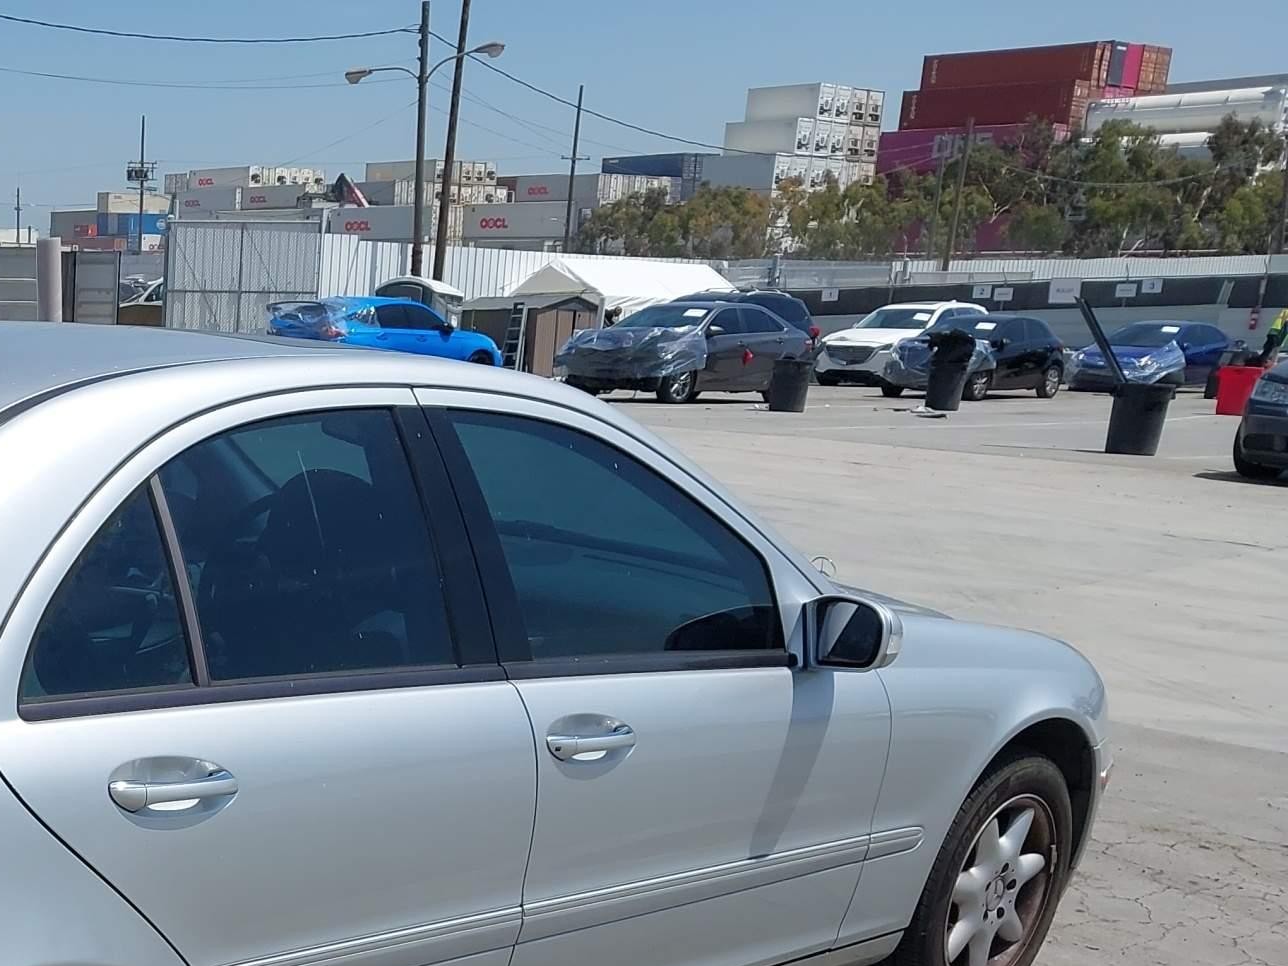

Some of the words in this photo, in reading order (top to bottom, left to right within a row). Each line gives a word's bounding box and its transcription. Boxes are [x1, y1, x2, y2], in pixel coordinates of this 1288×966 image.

[527, 186, 549, 196] OOCL
[344, 221, 371, 232] OOCL
[480, 217, 509, 229] OOCL
